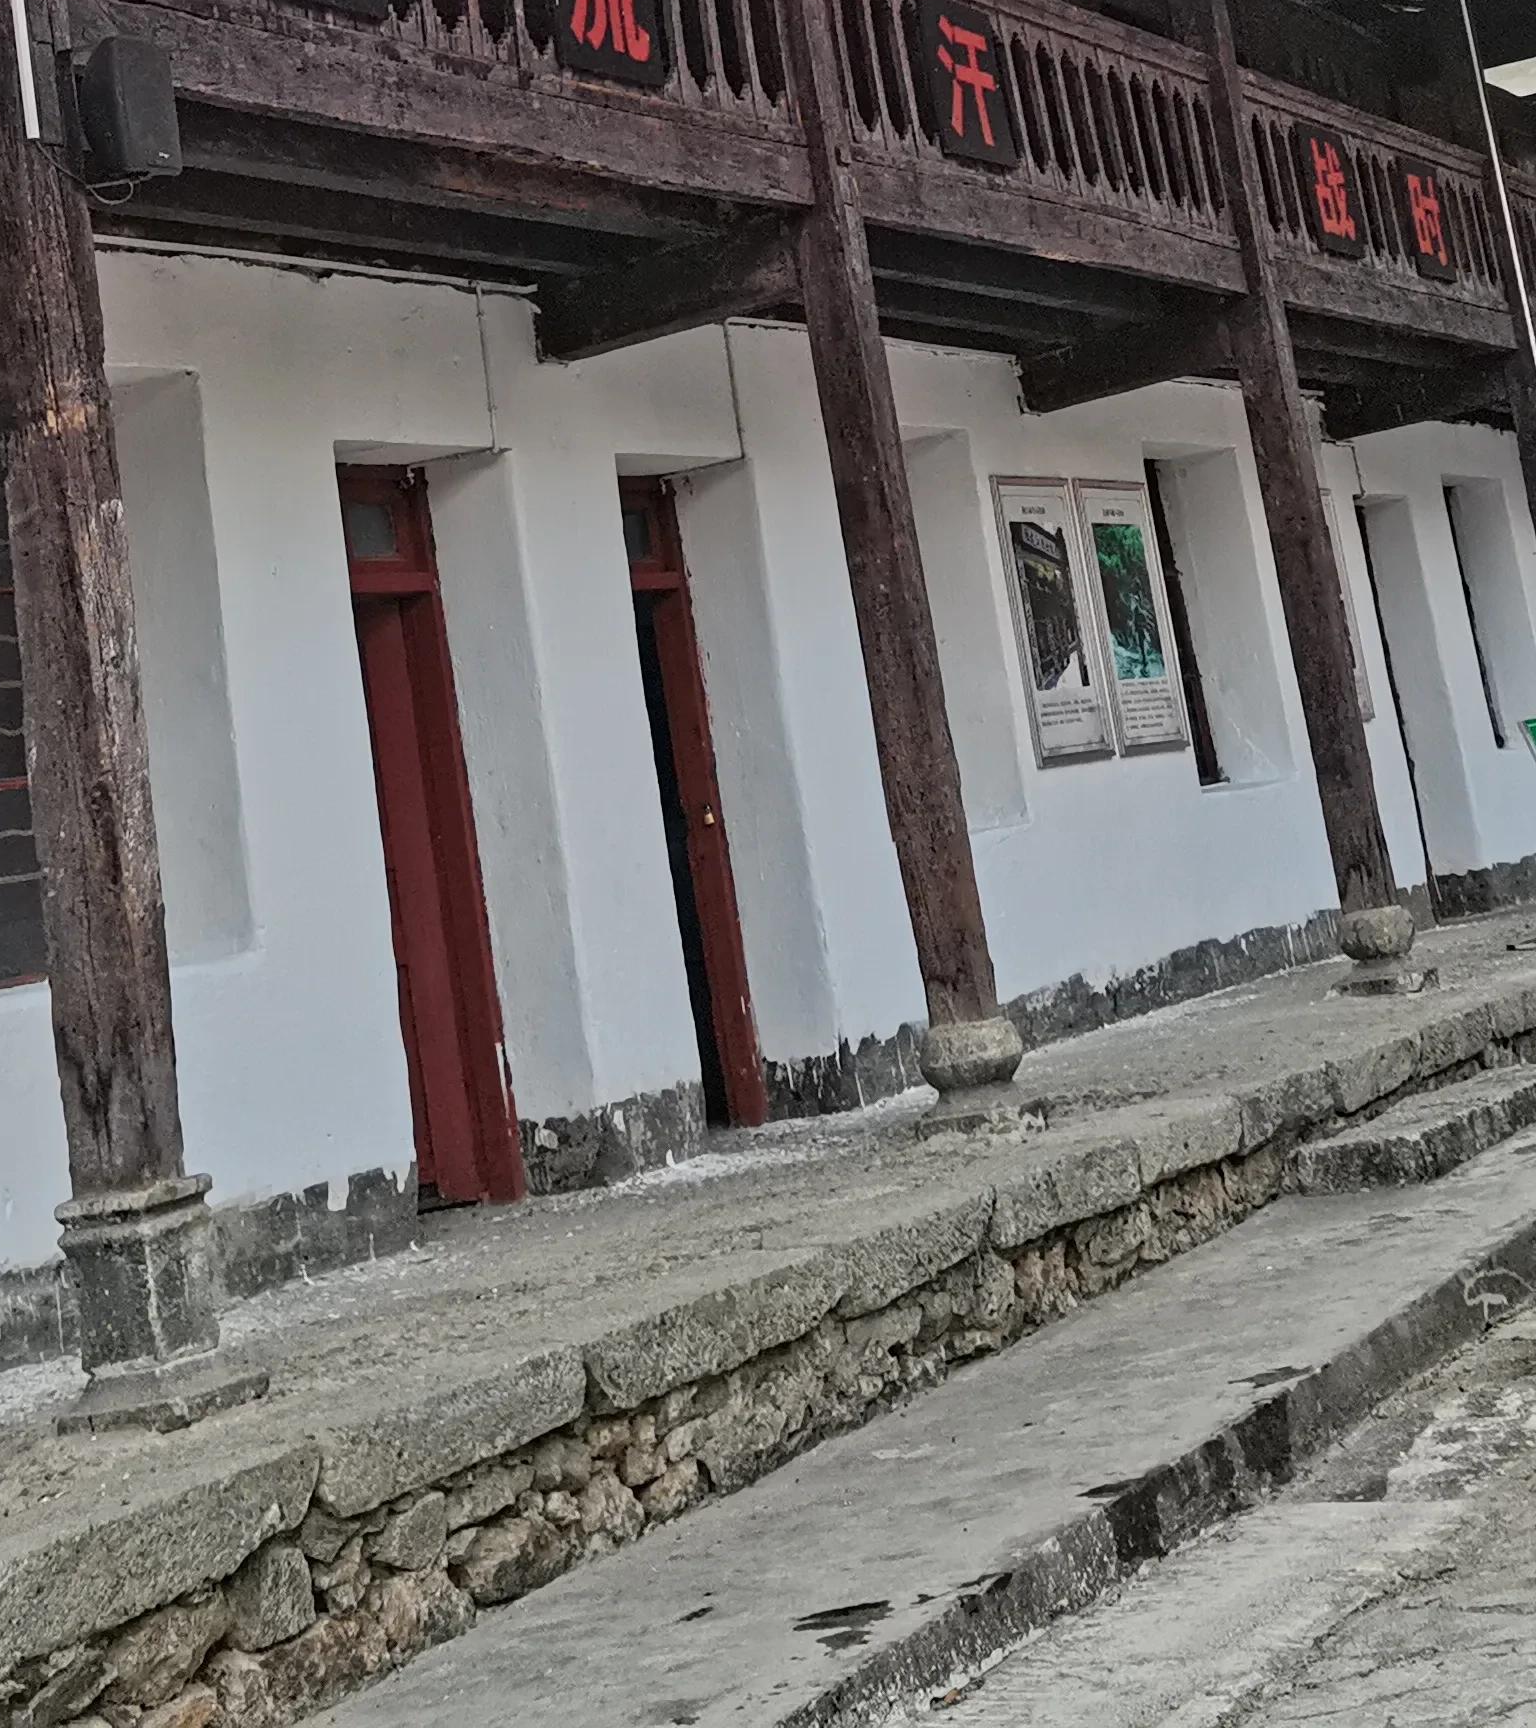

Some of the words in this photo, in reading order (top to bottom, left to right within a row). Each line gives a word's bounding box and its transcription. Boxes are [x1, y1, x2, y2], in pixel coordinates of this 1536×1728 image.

[937, 15, 997, 147] 汗
[1310, 138, 1357, 241] 战
[1407, 174, 1449, 267] 时
